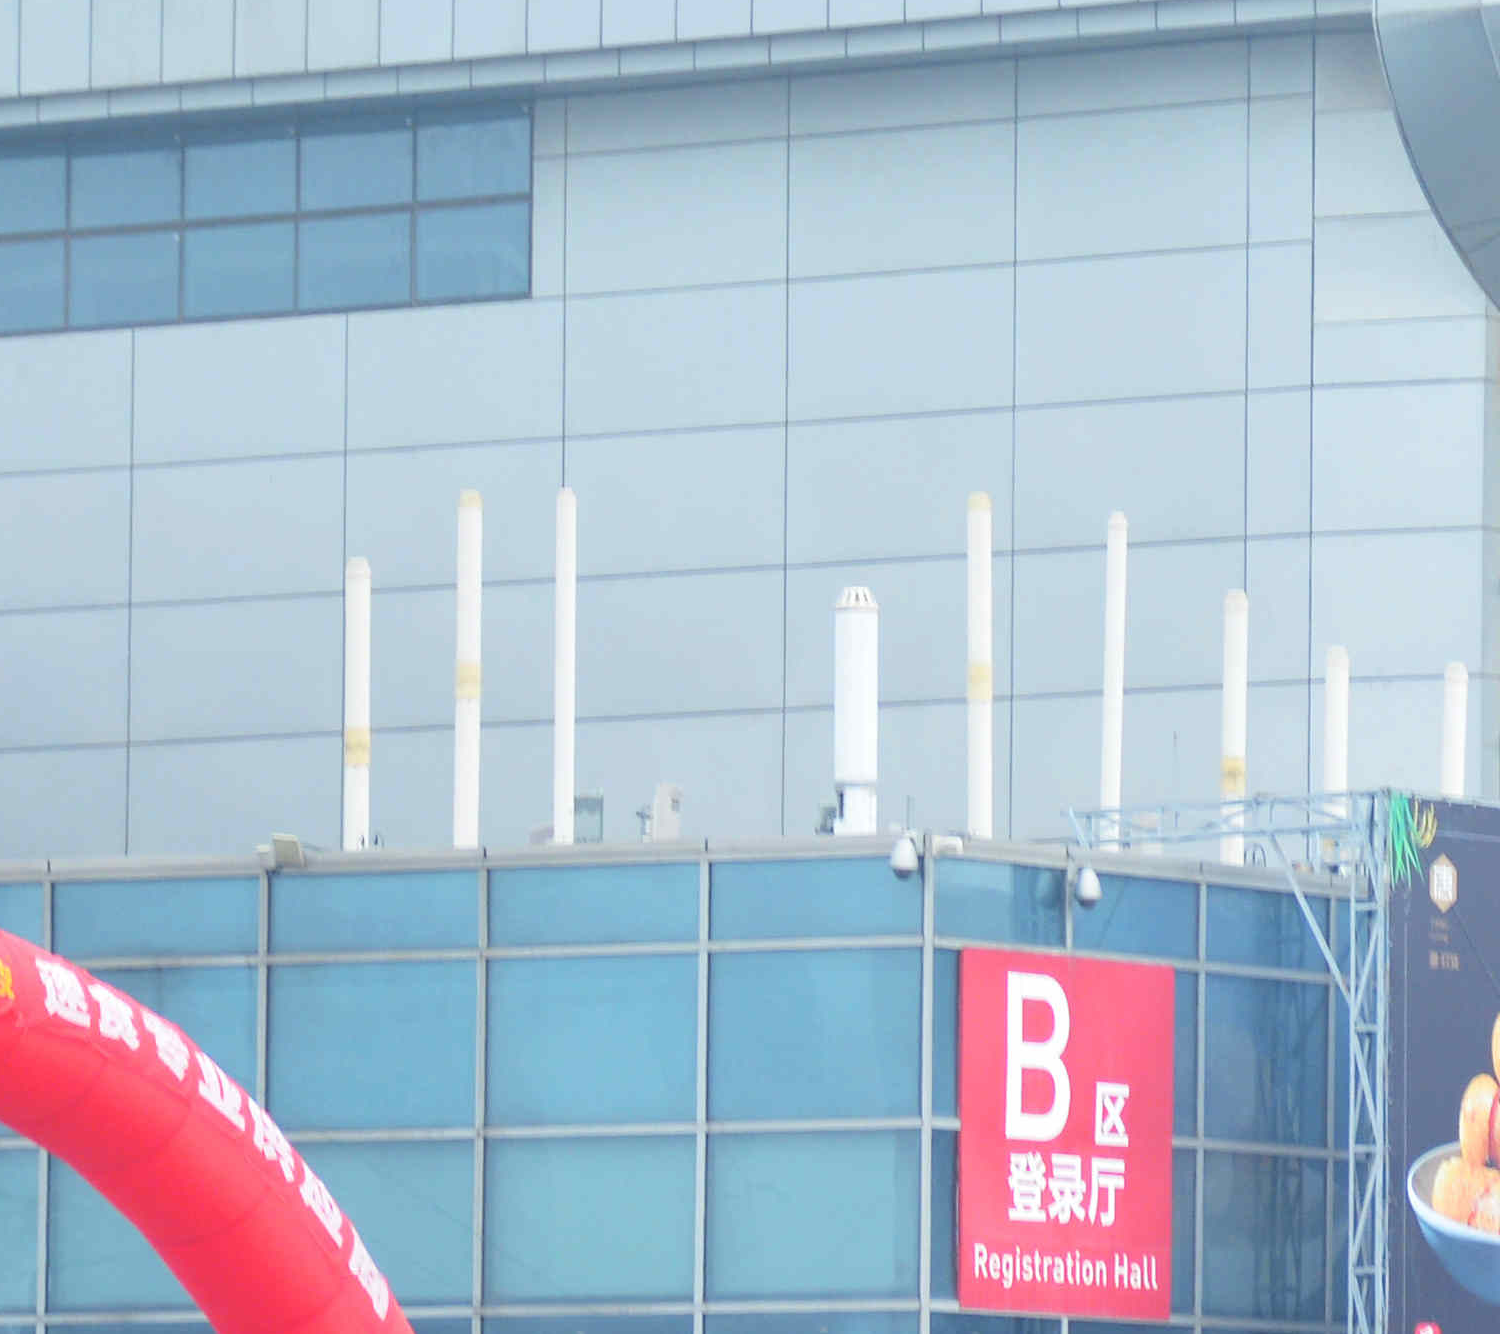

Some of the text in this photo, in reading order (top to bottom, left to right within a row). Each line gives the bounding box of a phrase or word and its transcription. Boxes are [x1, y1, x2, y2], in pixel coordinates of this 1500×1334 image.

[1007, 1150, 1126, 1228] 登录厅
[974, 1243, 1159, 1291] Registration Hall
